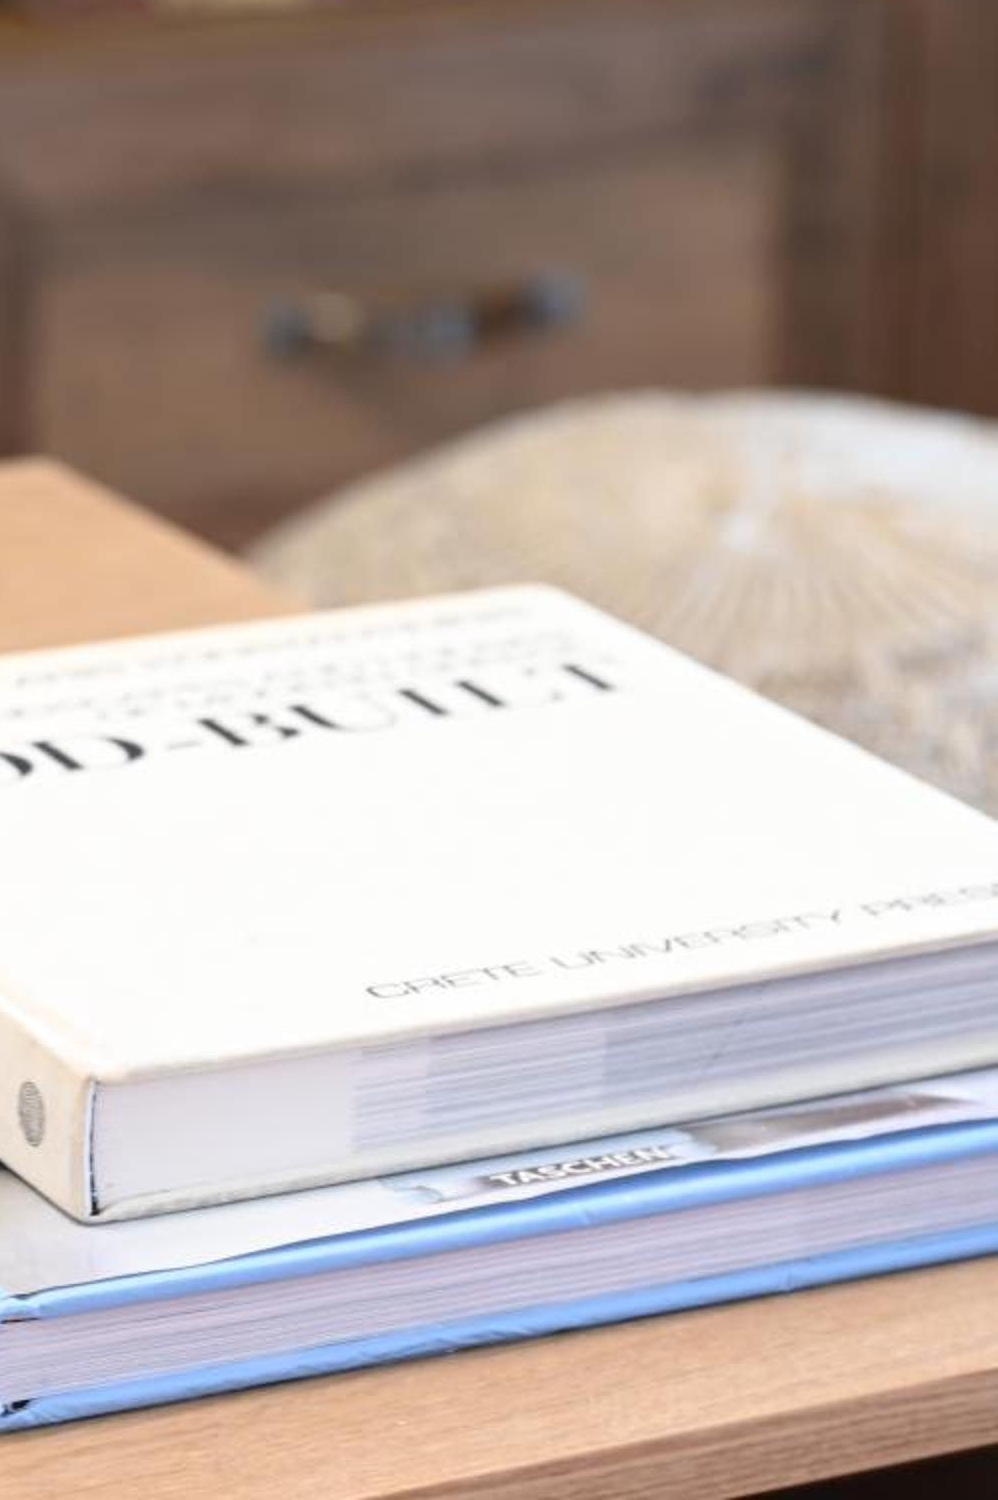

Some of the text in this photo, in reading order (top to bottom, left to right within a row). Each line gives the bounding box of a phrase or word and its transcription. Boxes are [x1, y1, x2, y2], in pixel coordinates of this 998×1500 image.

[365, 881, 998, 1001] CRETE UNIVERSITY PRES
[488, 1144, 672, 1186] TASCHEN
